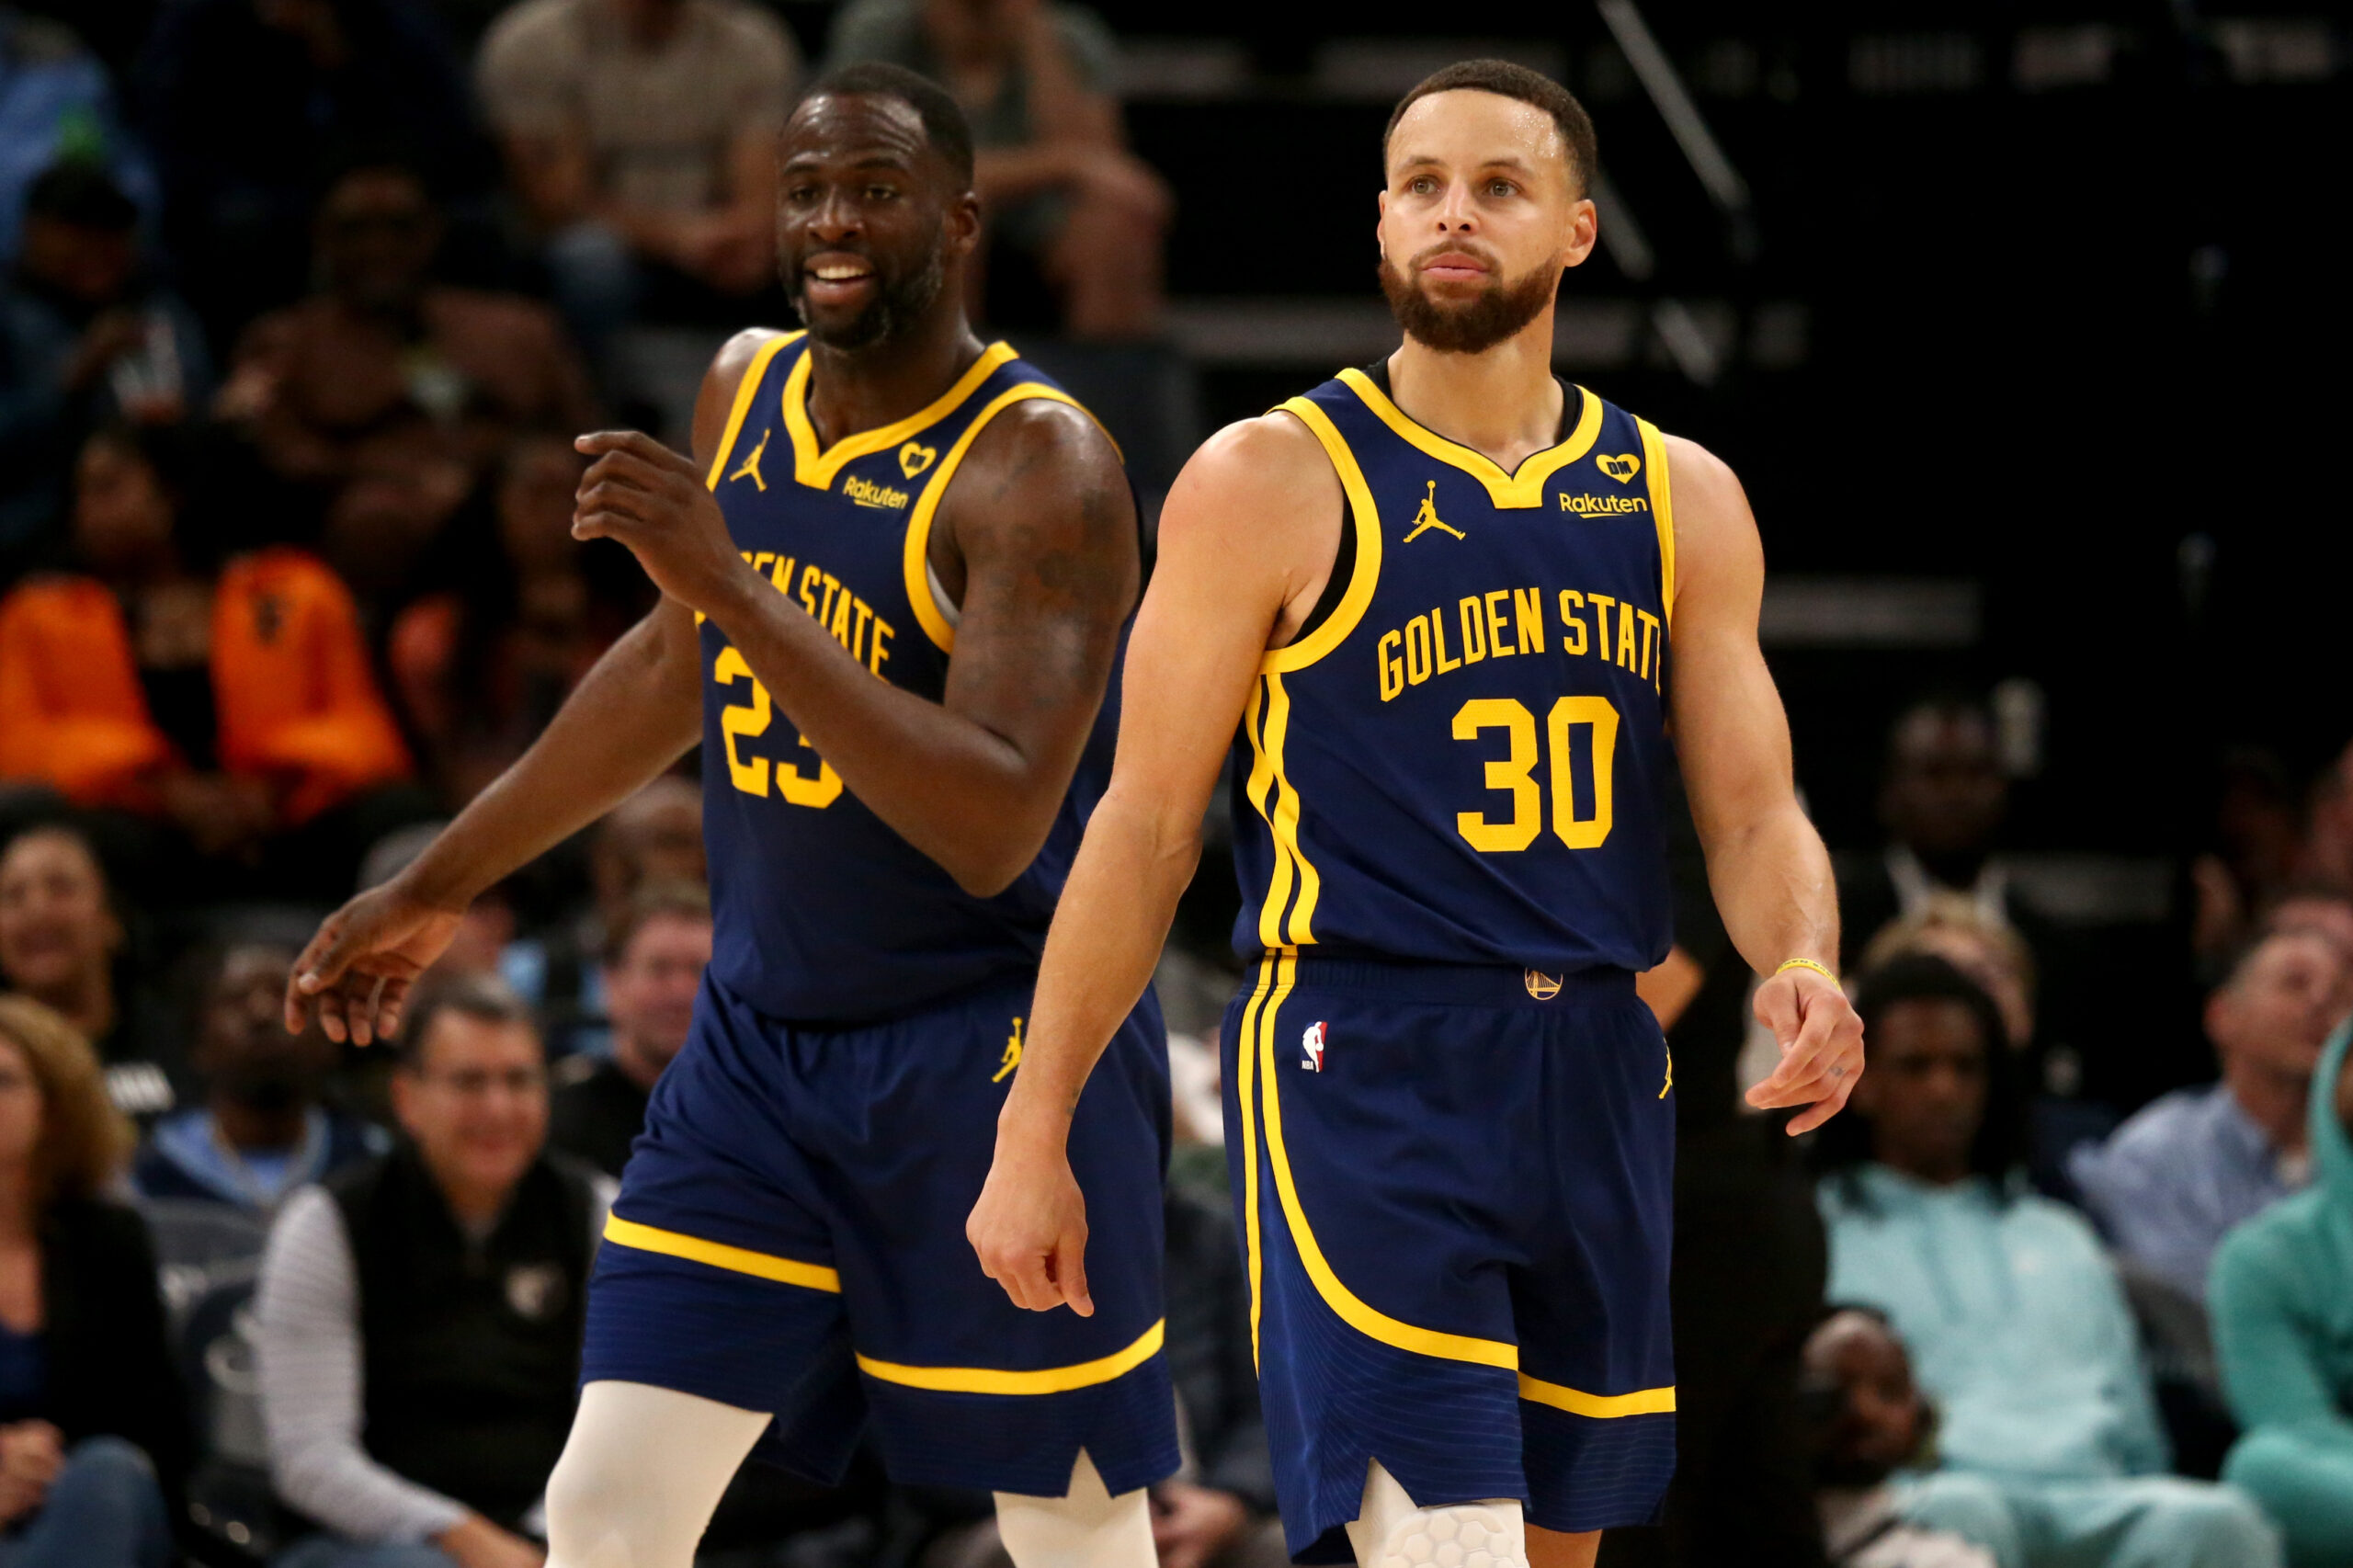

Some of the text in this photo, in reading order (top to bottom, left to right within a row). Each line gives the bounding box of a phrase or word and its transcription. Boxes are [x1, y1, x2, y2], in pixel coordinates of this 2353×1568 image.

[1606, 460, 1633, 475] DM
[843, 474, 909, 509] Rakuten
[1559, 493, 1648, 519] Rakuten
[799, 564, 895, 686] STATE
[1377, 587, 1661, 702] GOLDEN STAT
[1451, 696, 1620, 853] 30
[1302, 1060, 1314, 1071] NBA
